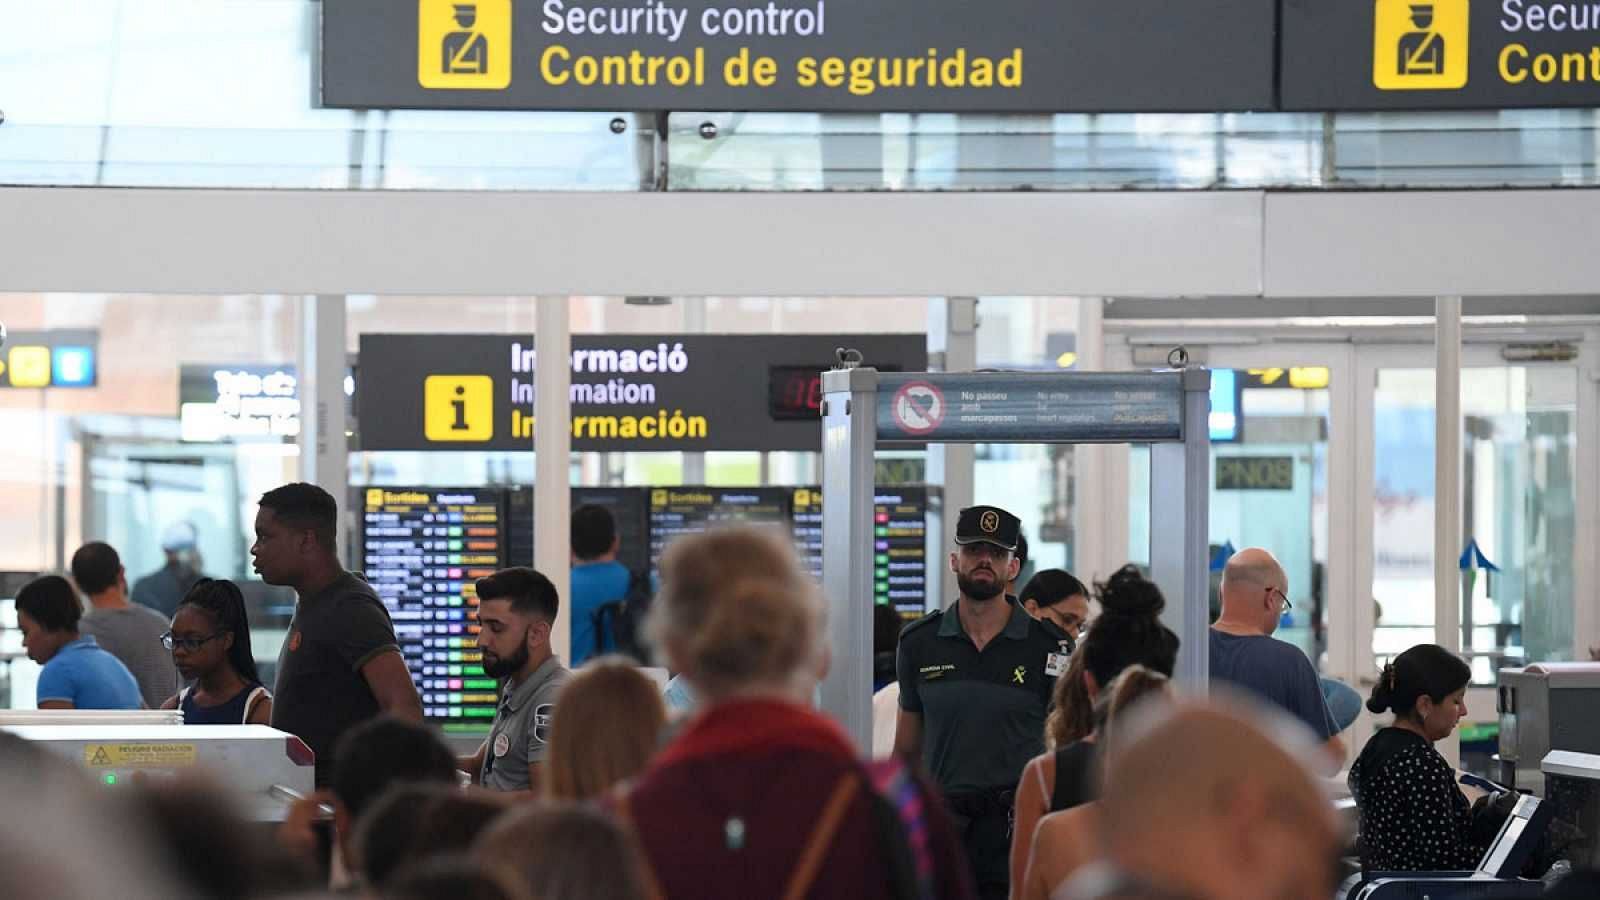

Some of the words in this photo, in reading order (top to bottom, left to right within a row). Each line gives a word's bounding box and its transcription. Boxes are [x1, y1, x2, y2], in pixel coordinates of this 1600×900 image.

[541, 0, 688, 42] Security
[701, 2, 825, 35] control
[1500, 0, 1600, 32] Secur
[540, 45, 705, 86] Control
[723, 47, 777, 87] de
[797, 47, 1023, 95] seguridad
[1498, 43, 1600, 84] Cont
[511, 343, 689, 373] Inrmació
[511, 378, 656, 403] Inmation
[511, 409, 707, 438] Inrmación
